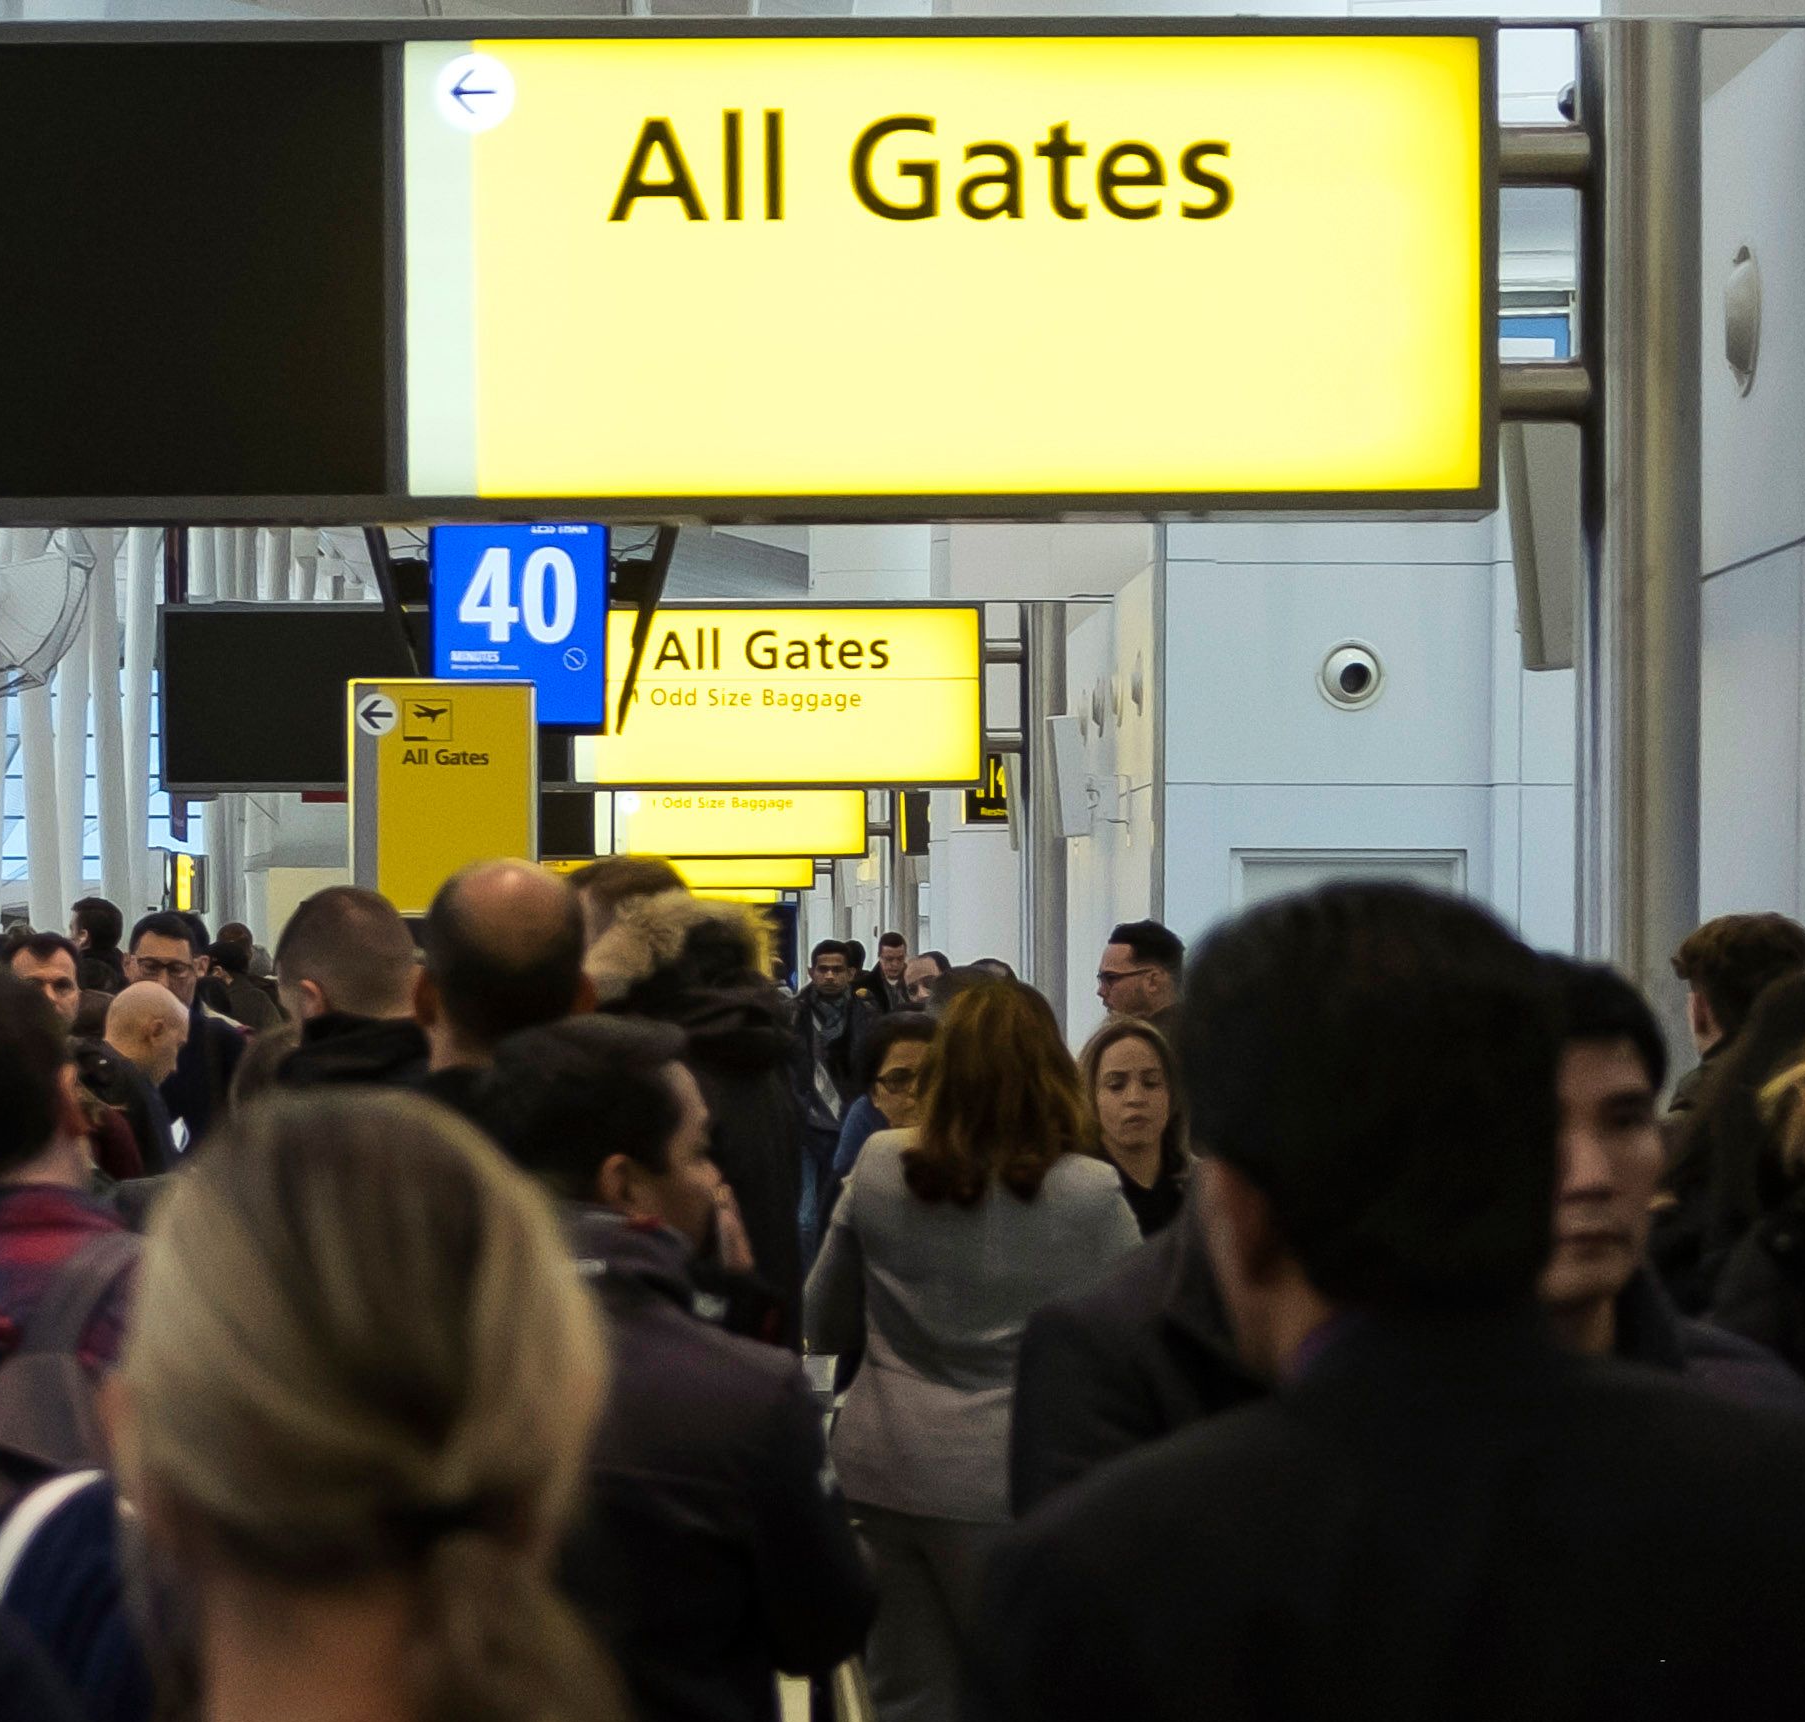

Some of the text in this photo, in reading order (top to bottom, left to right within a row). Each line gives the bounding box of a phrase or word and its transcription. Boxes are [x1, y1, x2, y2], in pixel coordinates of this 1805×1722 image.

[608, 108, 1234, 222] All Gates
[458, 546, 578, 644] 40
[653, 627, 890, 670] All Gates
[650, 686, 862, 712] Odd Size Baggage
[401, 748, 489, 766] All Gates
[661, 796, 794, 811] Odd Size Baggage
